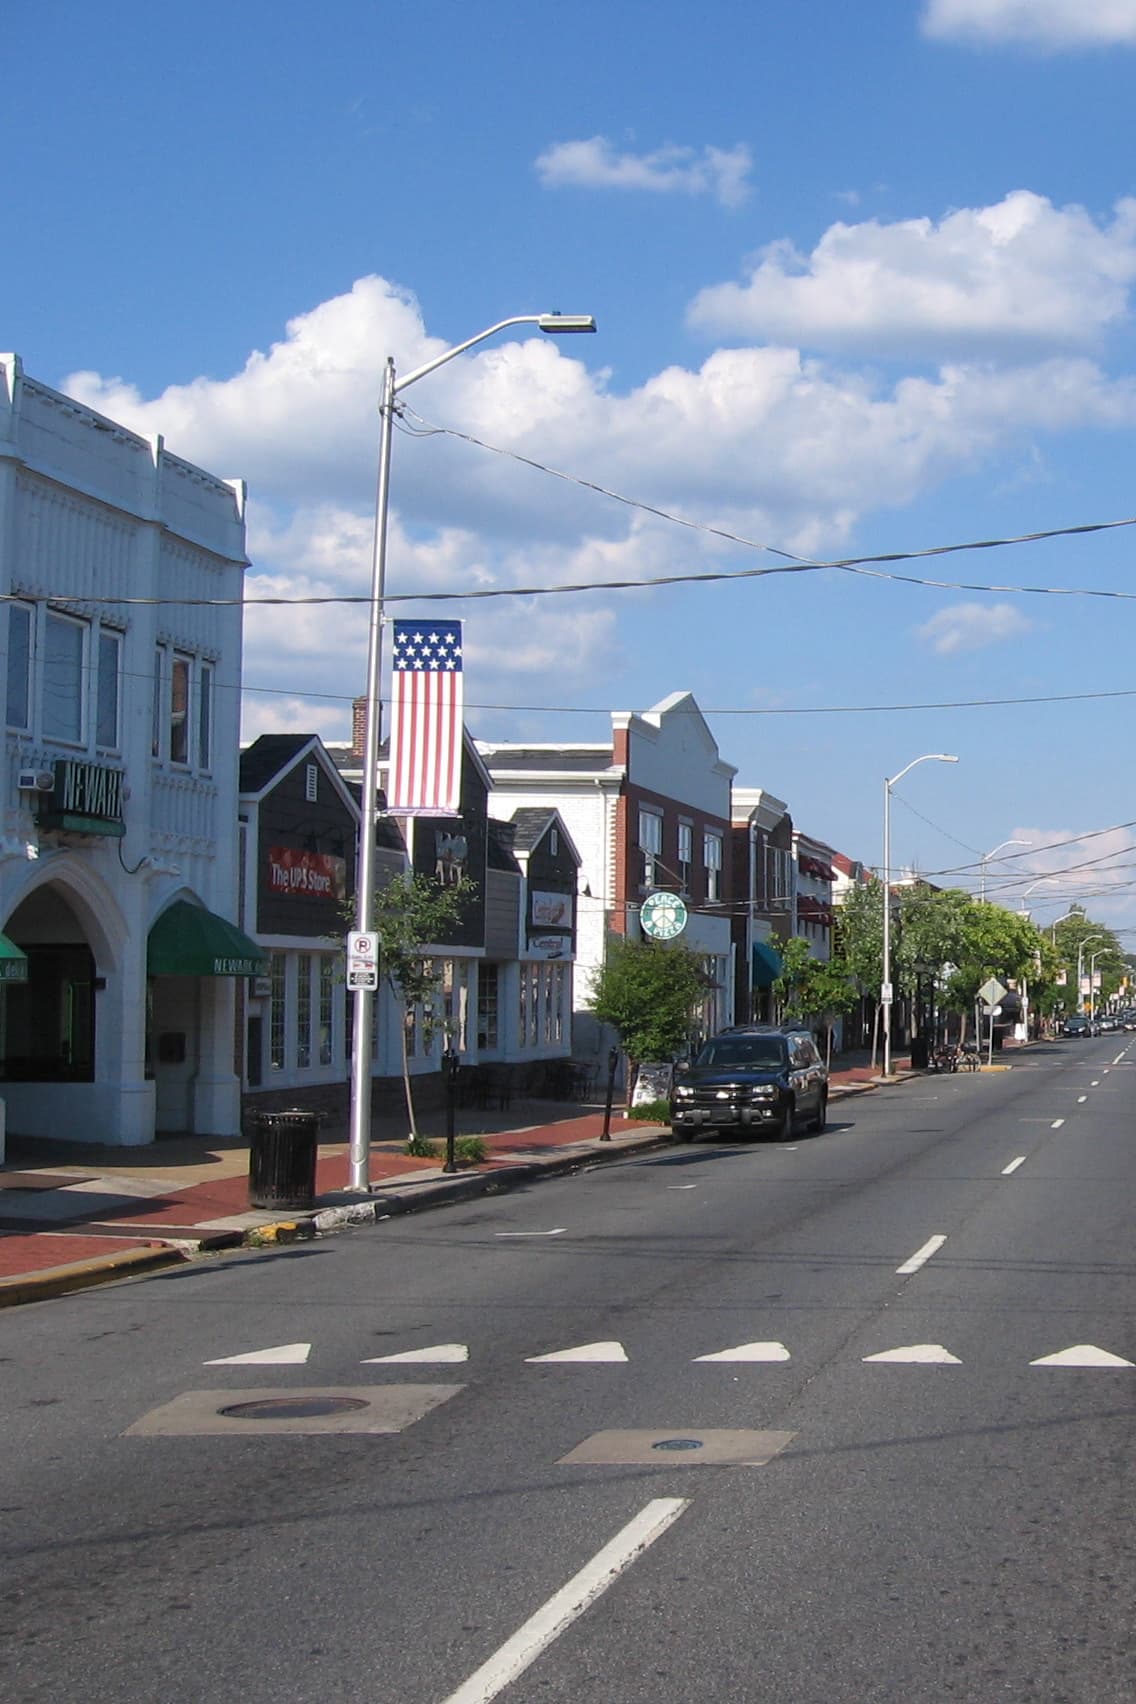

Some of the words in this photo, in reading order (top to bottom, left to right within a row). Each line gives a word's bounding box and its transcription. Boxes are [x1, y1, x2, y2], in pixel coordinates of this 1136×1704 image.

[271, 863, 289, 887] The
[290, 866, 308, 889] UPS
[308, 869, 331, 893] Store
[647, 894, 681, 909] PEACE
